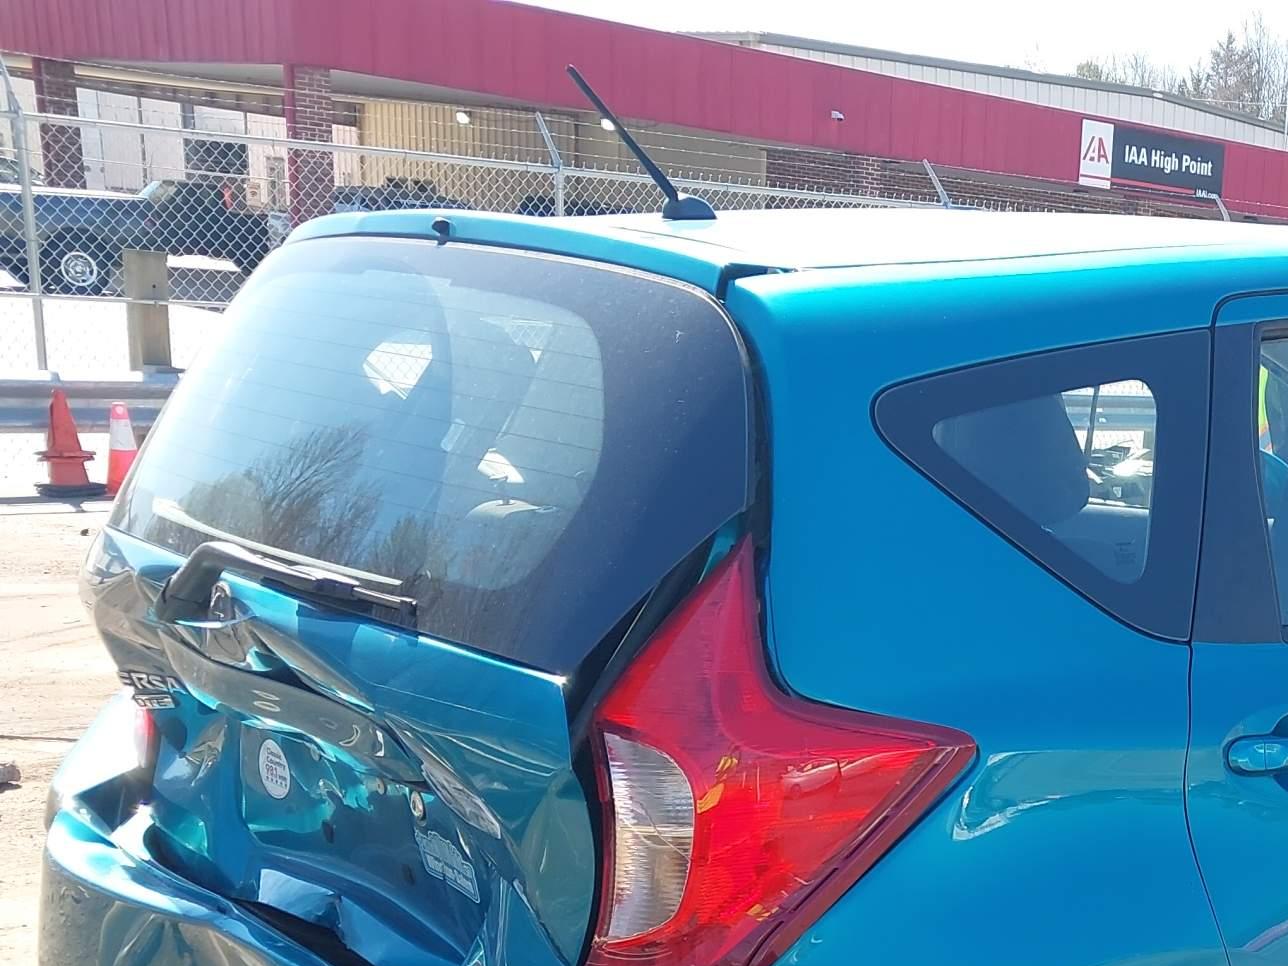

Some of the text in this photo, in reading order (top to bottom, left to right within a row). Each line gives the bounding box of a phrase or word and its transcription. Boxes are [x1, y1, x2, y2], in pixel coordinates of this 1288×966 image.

[1124, 144, 1213, 177] IAA High Point
